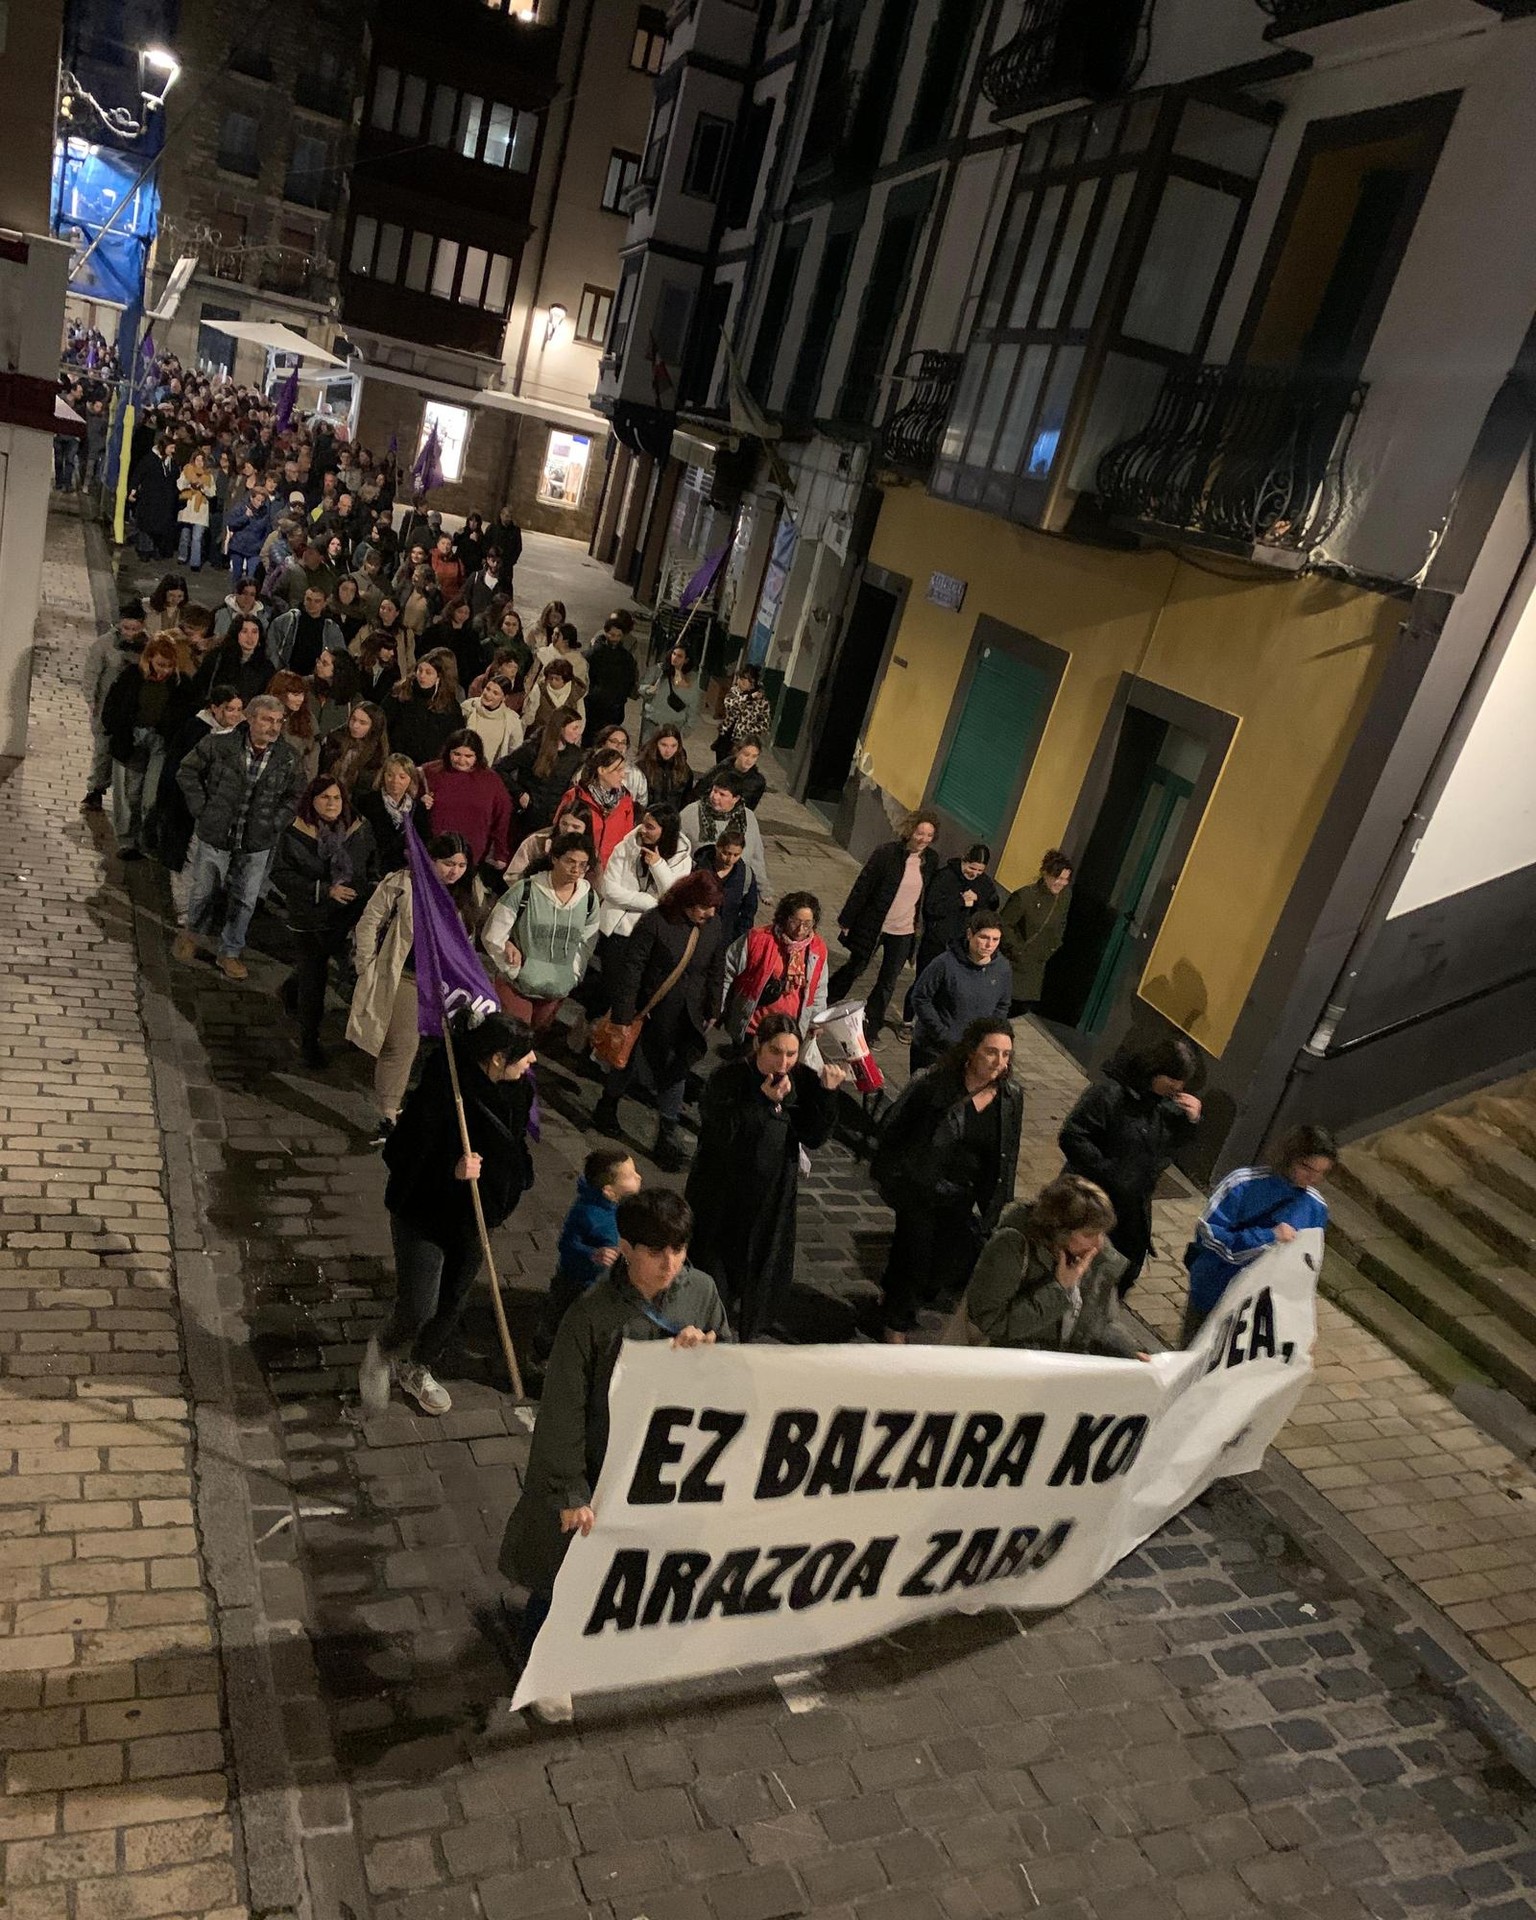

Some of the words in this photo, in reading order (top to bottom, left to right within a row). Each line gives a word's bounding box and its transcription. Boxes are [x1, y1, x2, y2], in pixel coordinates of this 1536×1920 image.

[626, 1405, 748, 1506] EZ
[753, 1406, 1047, 1500] BAZARA
[581, 1534, 900, 1638] ARAZOA
